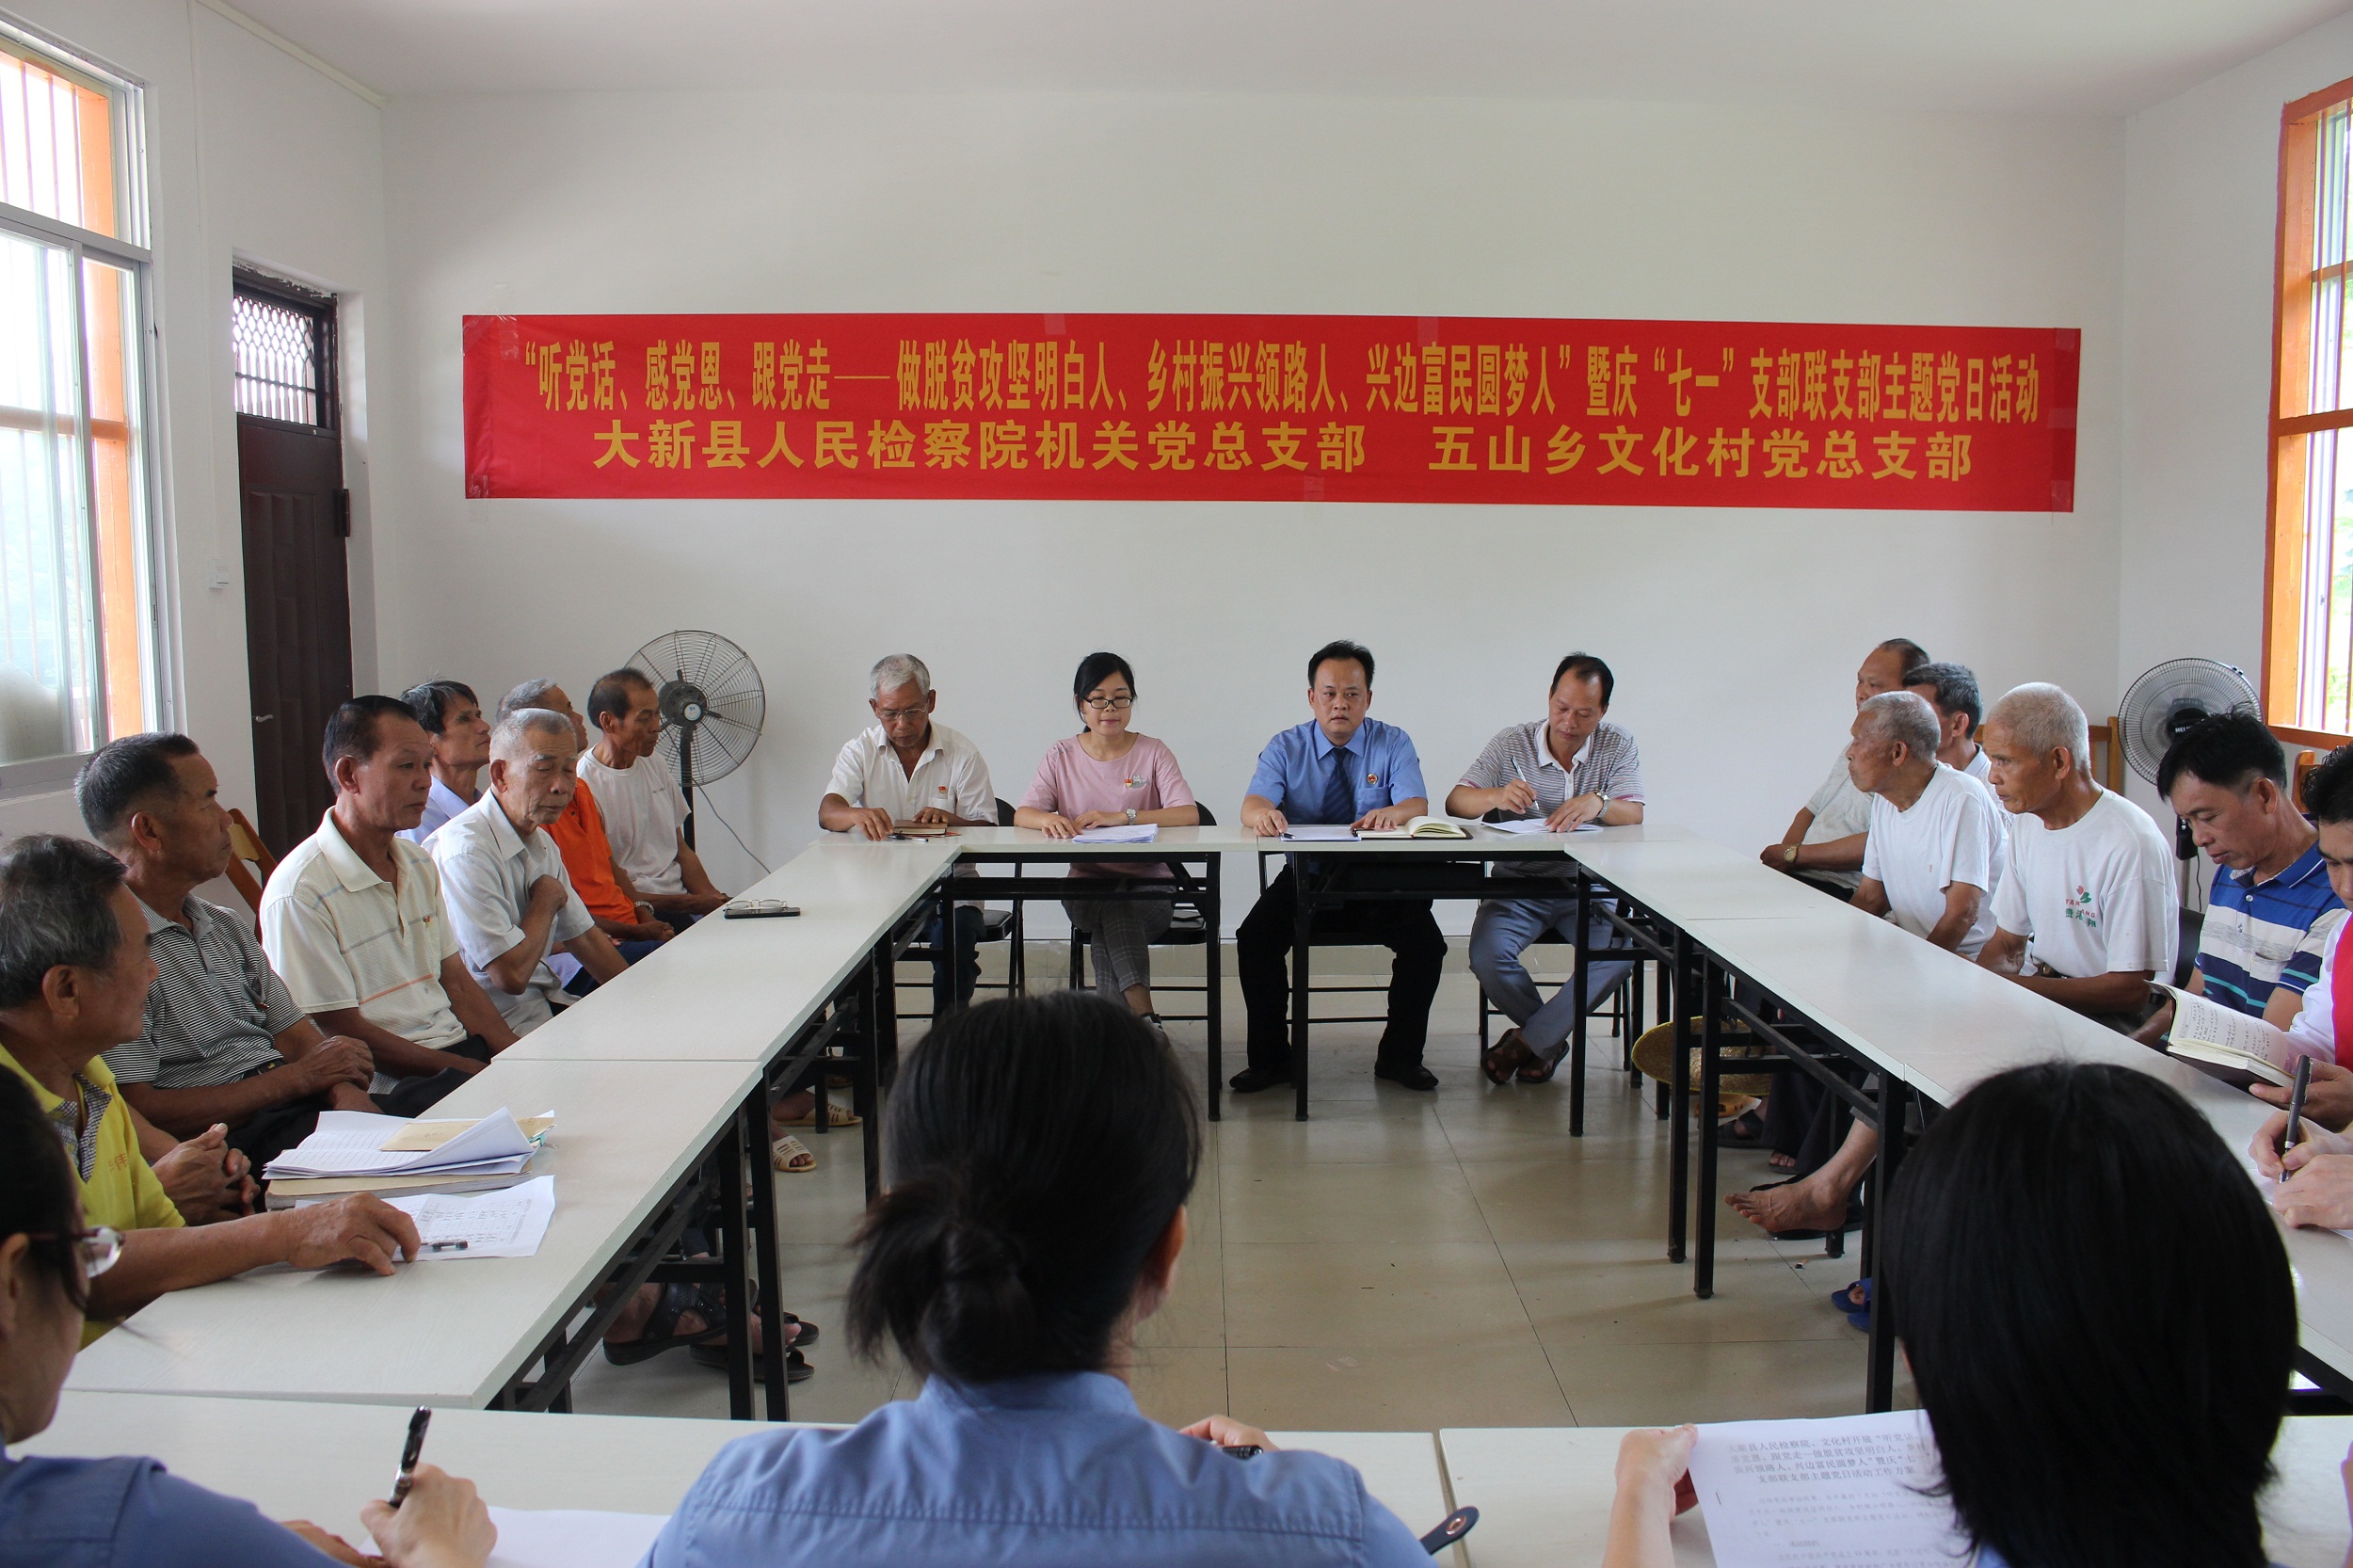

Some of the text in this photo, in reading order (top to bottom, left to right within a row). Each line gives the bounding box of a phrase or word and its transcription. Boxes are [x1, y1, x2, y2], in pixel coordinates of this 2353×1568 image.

[594, 419, 1971, 481] 大新县人民检察院机关党总支部 五山乡文化村党总支部
